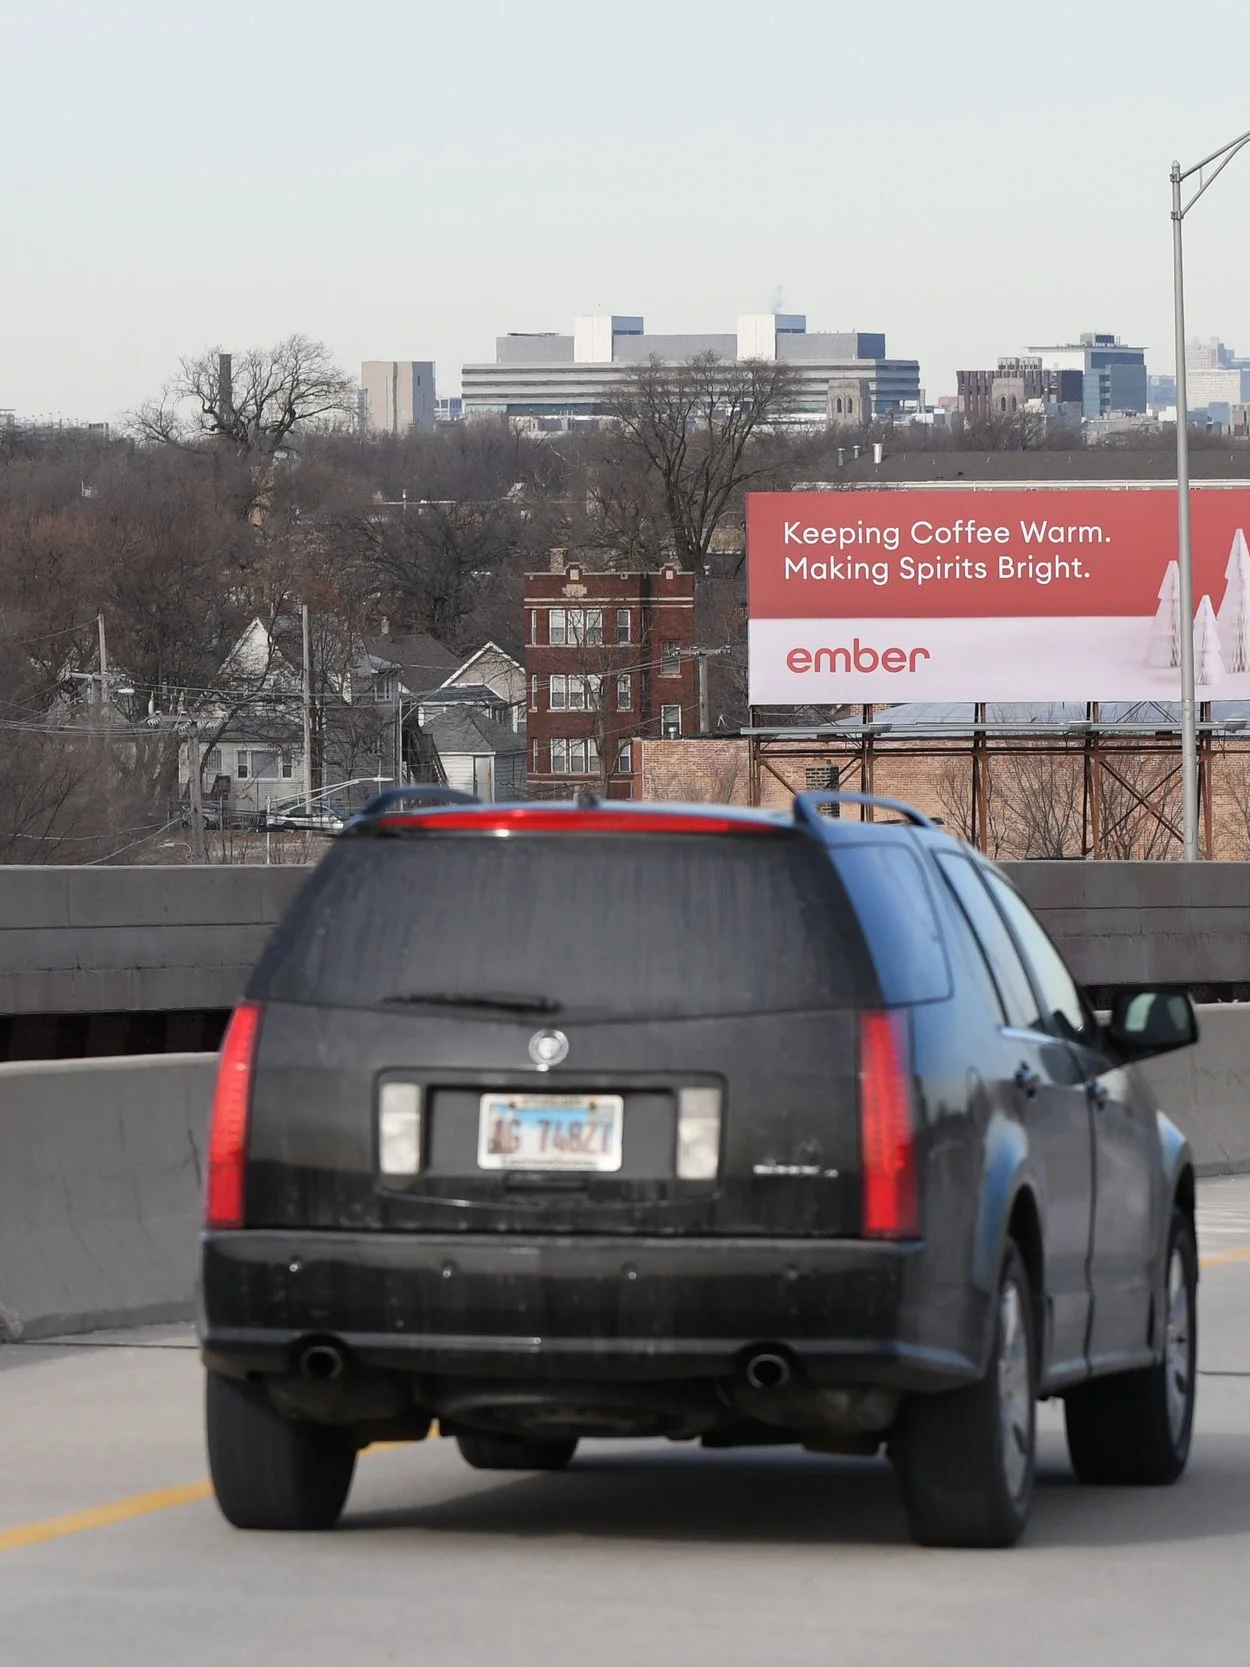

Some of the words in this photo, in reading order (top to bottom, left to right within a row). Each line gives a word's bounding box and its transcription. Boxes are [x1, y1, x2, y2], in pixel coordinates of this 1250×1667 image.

[784, 520, 900, 550] Keeping
[911, 519, 1010, 544] Coffee
[1020, 520, 1111, 543] Warm.
[785, 555, 889, 586] Making
[900, 555, 987, 586] Spirits
[999, 554, 1090, 585] Bright.
[786, 638, 930, 673] ember
